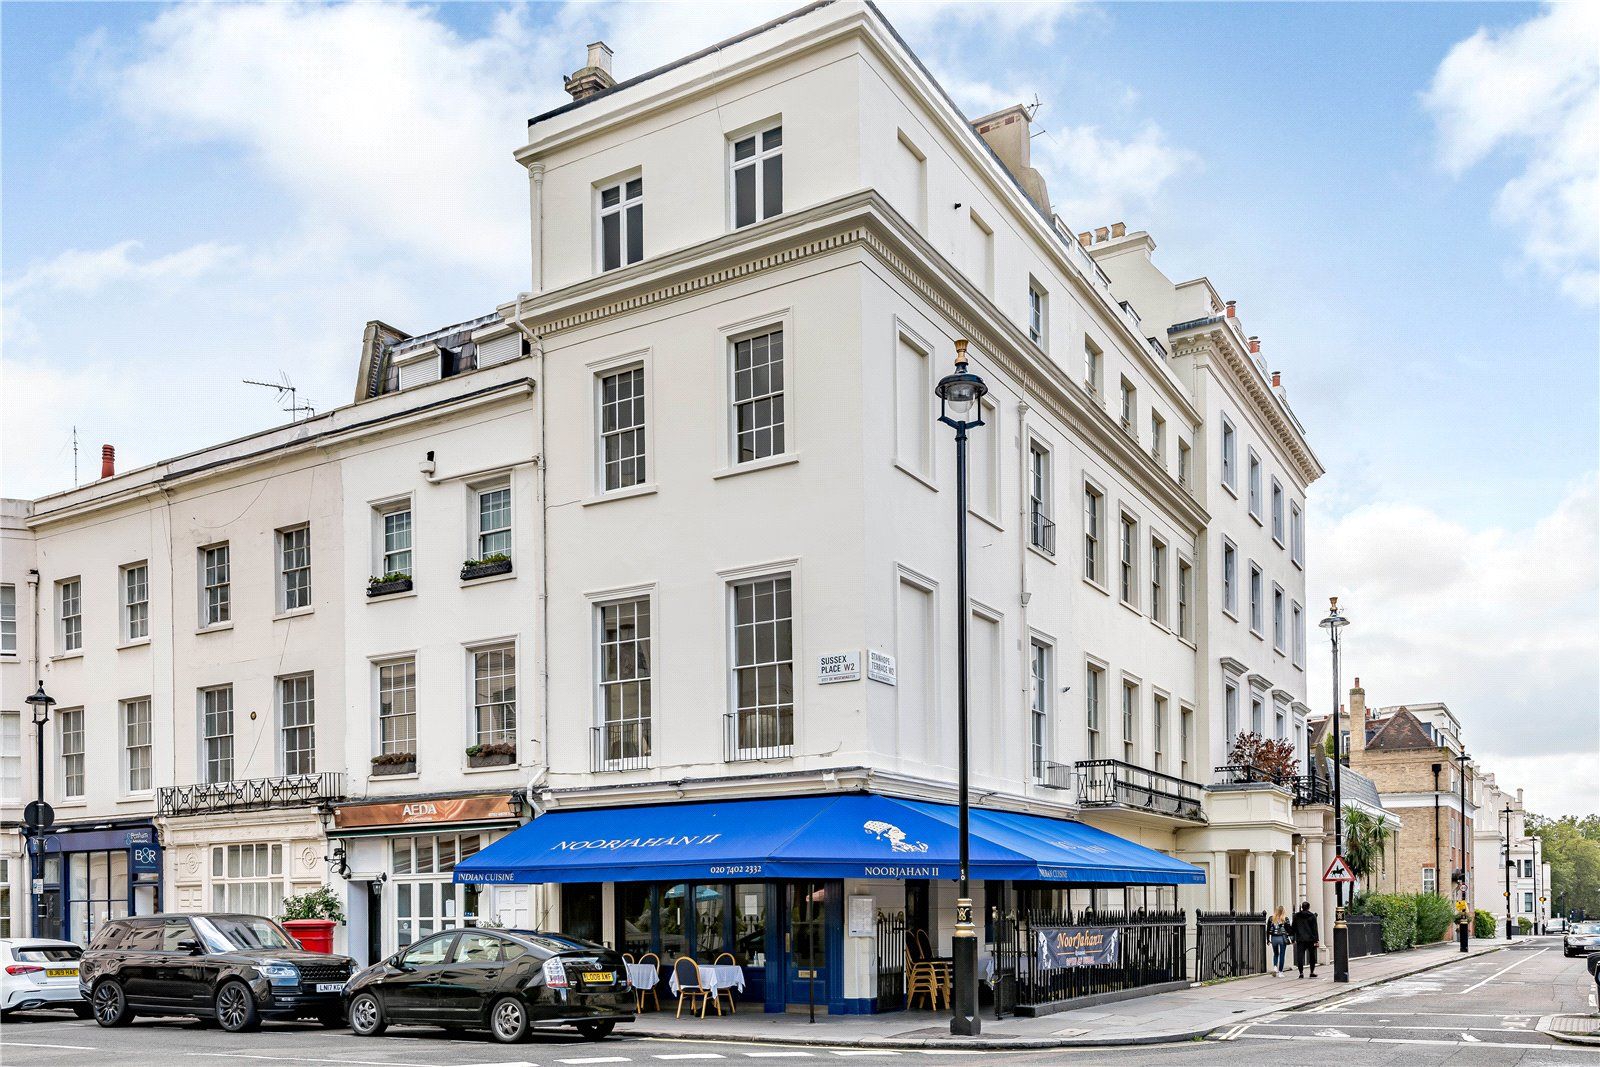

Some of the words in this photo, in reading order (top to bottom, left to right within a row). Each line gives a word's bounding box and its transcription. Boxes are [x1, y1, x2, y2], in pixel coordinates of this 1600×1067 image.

[821, 655, 847, 666] SUSSEX
[871, 652, 891, 666] STANHOPE
[821, 665, 841, 674] PLACE
[844, 663, 855, 672] W2
[871, 661, 888, 674] TERRACE
[402, 804, 438, 816] AEDA
[551, 835, 699, 851] NOORJAHAN
[697, 833, 722, 846] II
[135, 847, 157, 864] B&R
[710, 866, 725, 874] 020
[726, 866, 744, 875] 7402
[745, 865, 762, 875] 2332
[864, 867, 930, 878] NOORJAHAN
[932, 867, 939, 876] II
[458, 873, 484, 881] INDIAN
[484, 873, 515, 881] CUISINE
[1056, 930, 1098, 949] NoorJahan
